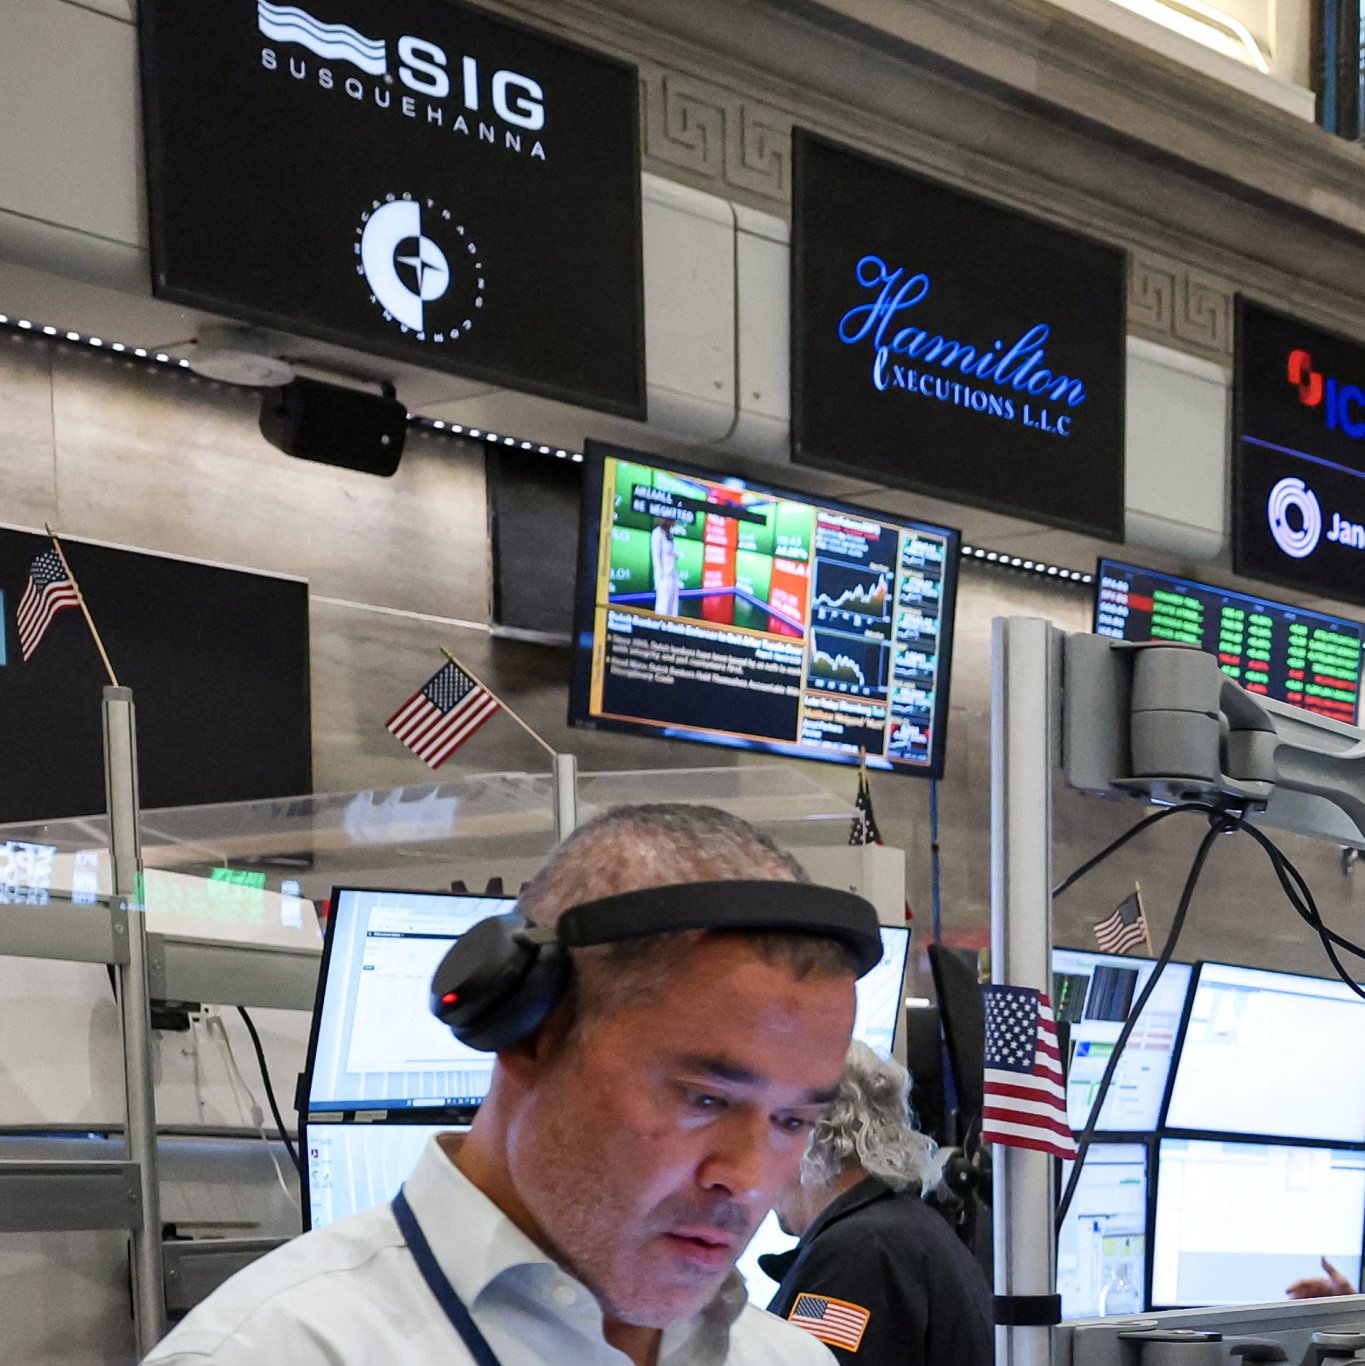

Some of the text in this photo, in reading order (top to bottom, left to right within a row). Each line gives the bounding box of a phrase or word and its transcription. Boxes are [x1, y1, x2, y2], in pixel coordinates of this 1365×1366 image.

[261, 48, 547, 161] SUSQUEHANNA
[397, 35, 546, 131] SIG
[838, 254, 1088, 407] Hamilton
